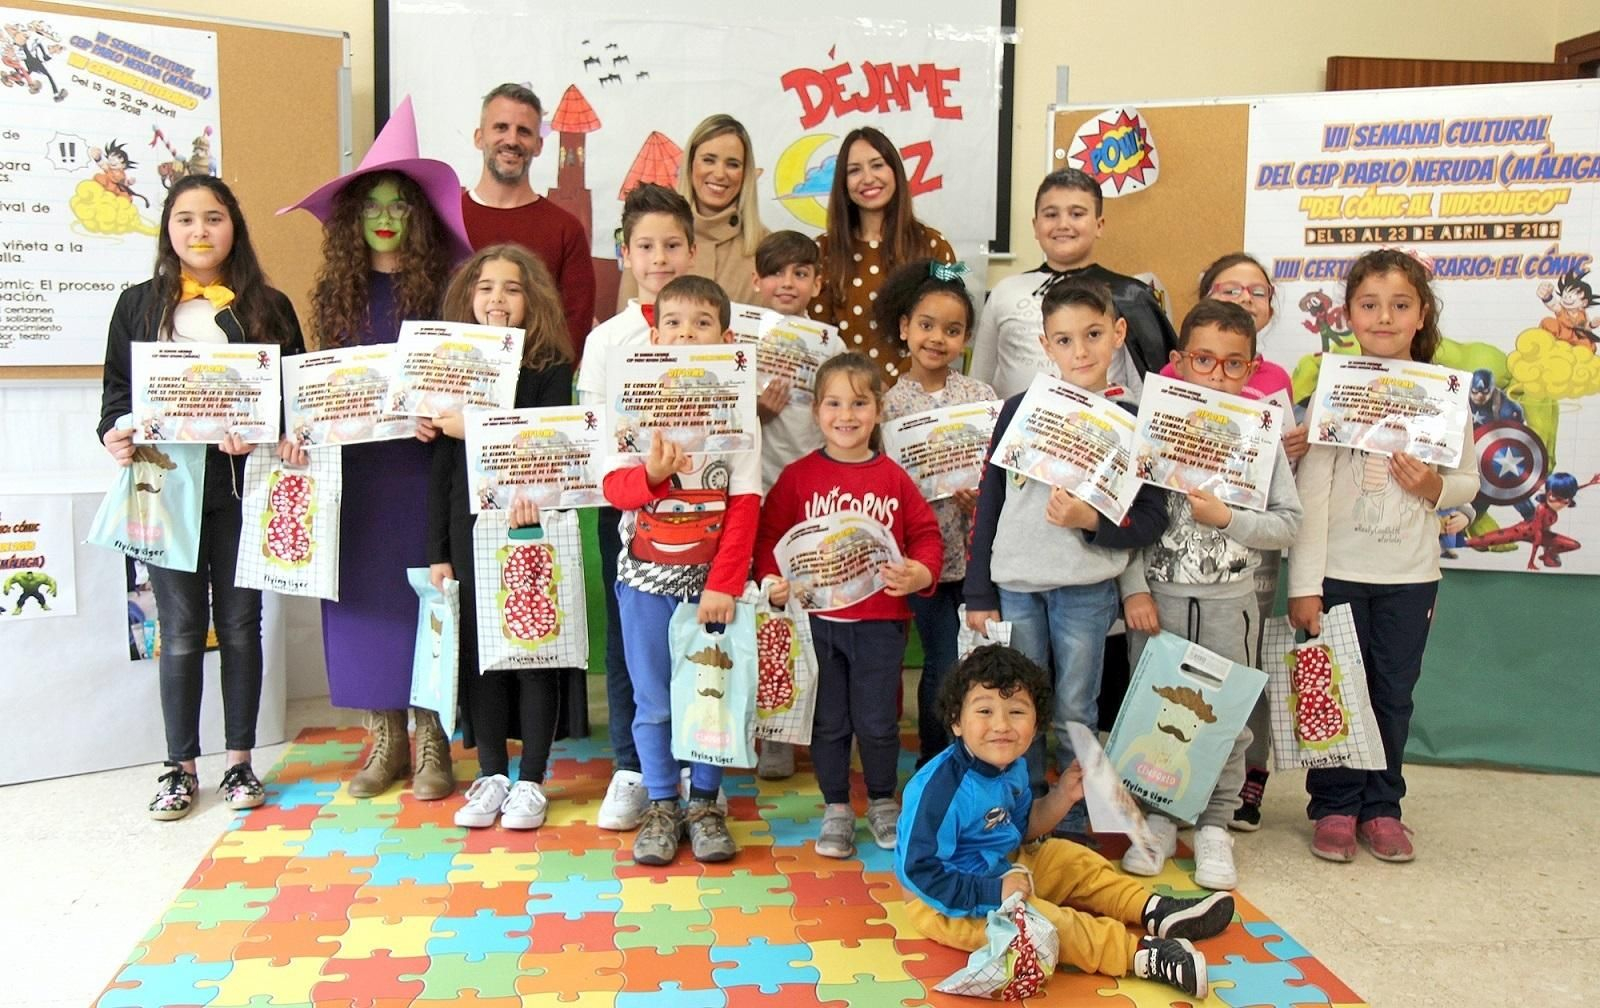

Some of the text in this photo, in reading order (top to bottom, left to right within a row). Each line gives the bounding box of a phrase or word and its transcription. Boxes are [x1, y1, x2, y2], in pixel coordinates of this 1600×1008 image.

[110, 38, 151, 61] SEMANA
[151, 55, 195, 79] CULTURAL
[124, 56, 161, 78] NERUDA
[71, 74, 176, 119] Del 13 al 23 de Abril
[781, 44, 963, 130] DÉJAME
[103, 96, 116, 107] de
[1323, 116, 1551, 150] VII SEMANA CULTURAL
[1257, 162, 1294, 189] DEL
[1296, 160, 1341, 187] CEIP
[1341, 158, 1409, 186] PABLO
[1410, 156, 1498, 183] NERUDA
[32, 203, 50, 213] de
[1344, 187, 1407, 219] CÓMIC
[1407, 193, 1433, 217] AL
[1439, 188, 1571, 217] VIDEOJUEGO"
[1306, 222, 1560, 244] DEL 13 AL 23 DE ABRIL DE 2108
[3, 240, 83, 253] viñeta a la
[1273, 257, 1300, 281] VIII
[1499, 254, 1523, 278] EL
[1524, 244, 1592, 278] CÓMIC
[40, 280, 52, 290] El
[59, 281, 115, 293] proceso
[114, 540, 140, 556] flying
[264, 574, 287, 588] flying
[691, 750, 734, 765] flying tiger
[1301, 753, 1352, 768] flying tiger
[1122, 778, 1174, 806] flying tiger
